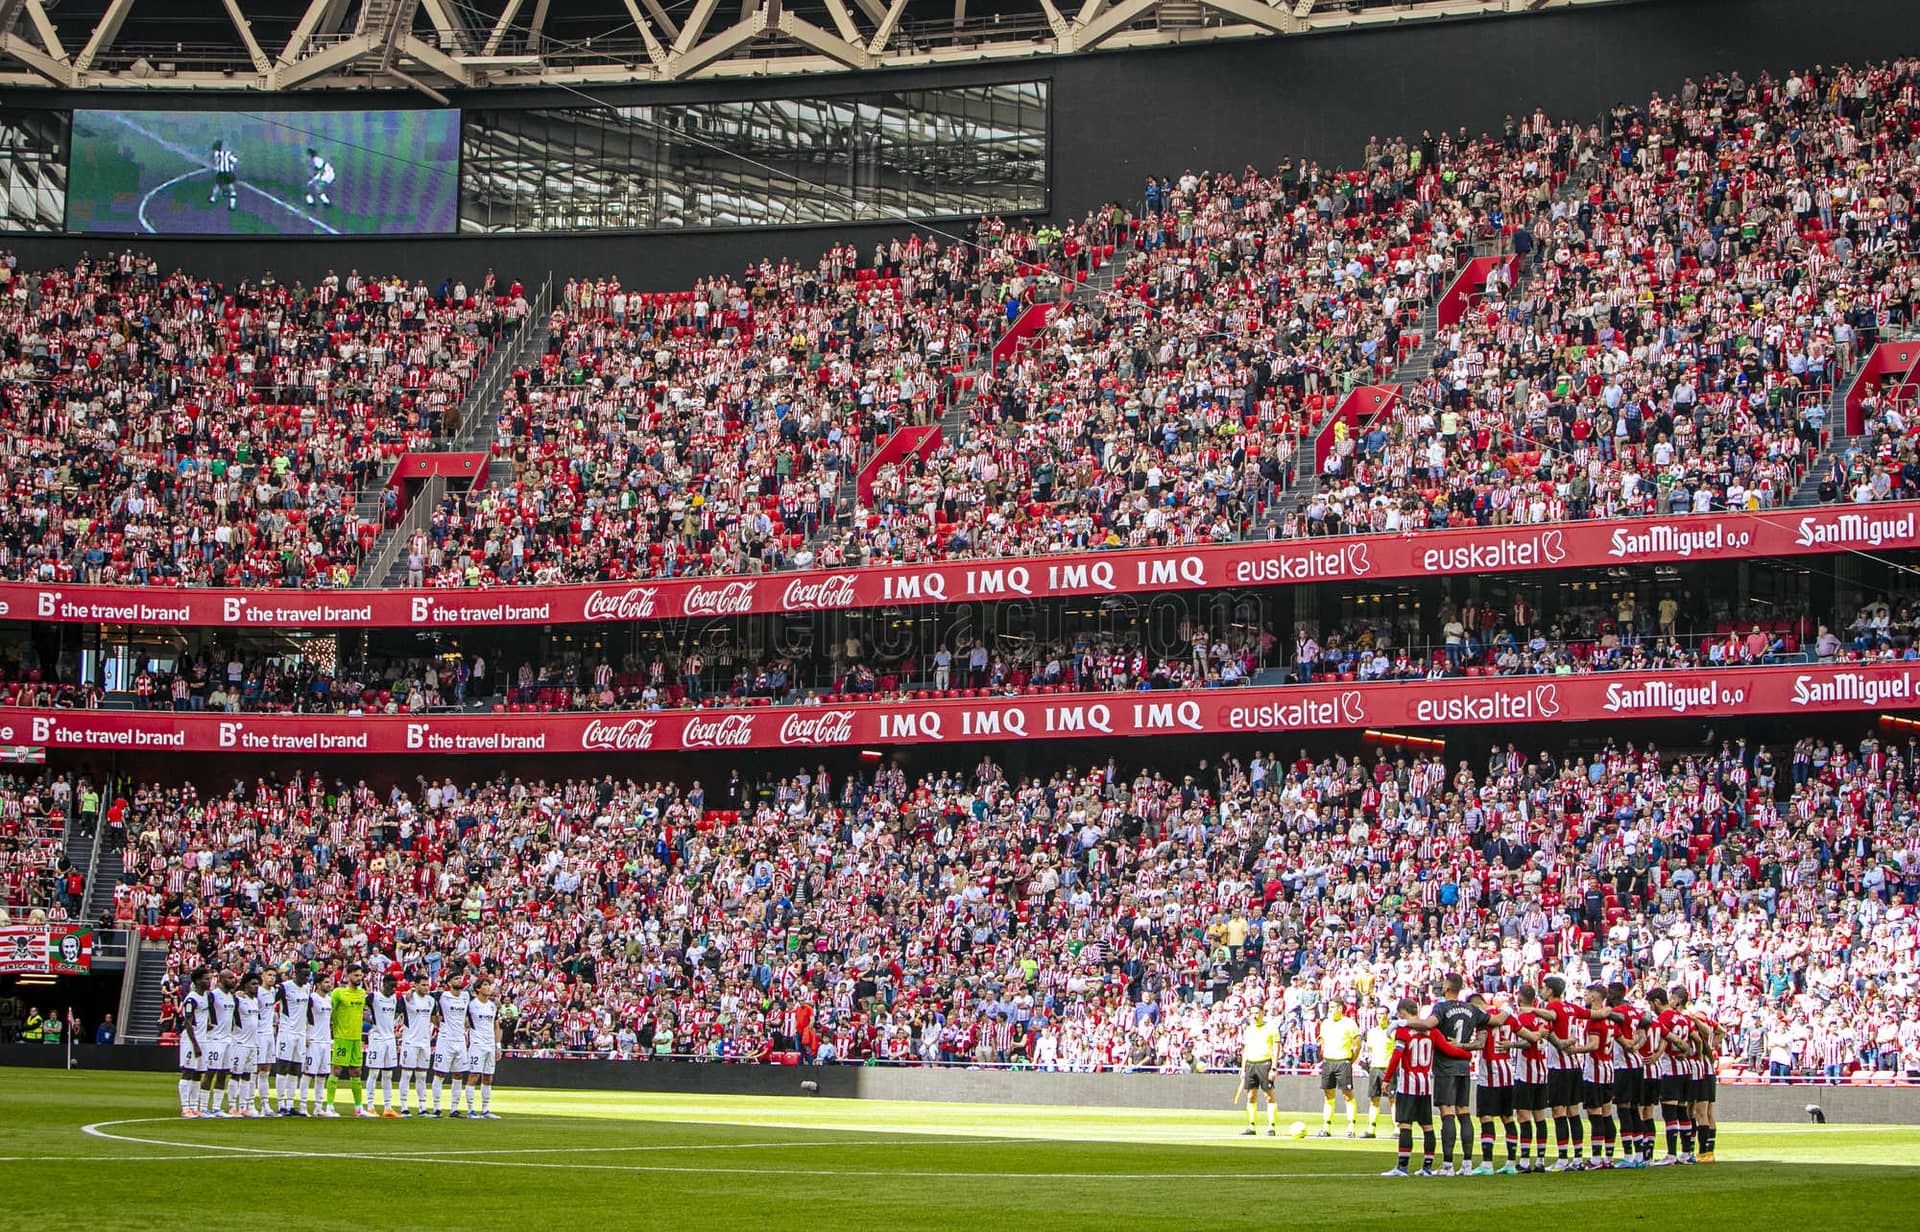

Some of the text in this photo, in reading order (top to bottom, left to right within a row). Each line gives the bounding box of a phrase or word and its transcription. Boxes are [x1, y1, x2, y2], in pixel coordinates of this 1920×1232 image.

[1237, 548, 1345, 582] euskaltel
[1424, 537, 1538, 571] euskaltel
[967, 567, 1033, 595] IMQ
[1049, 561, 1117, 590] IMQ
[1138, 556, 1207, 585] IMQ
[884, 573, 948, 601] IMQ
[61, 602, 88, 618] the
[91, 604, 138, 619] travel
[141, 605, 190, 621] brand
[246, 606, 273, 621] the
[276, 606, 321, 621] travel
[324, 605, 371, 621] brand
[433, 605, 457, 621] the
[460, 604, 502, 621] travel
[506, 603, 549, 620] brand
[1046, 703, 1114, 733] IMQ
[1134, 700, 1204, 730] IMQ
[1230, 697, 1338, 729] euskaltel
[1418, 690, 1531, 721] euskaltel
[55, 727, 83, 742] the
[86, 729, 132, 744] travel
[136, 730, 184, 745] brand
[880, 712, 944, 740] IMQ
[962, 708, 1029, 737] IMQ
[242, 732, 269, 747] the
[272, 733, 317, 748] travel
[320, 732, 367, 748] brand
[428, 733, 453, 748] the
[456, 733, 498, 748] travel
[501, 733, 544, 748] brand
[1453, 1019, 1465, 1044] 1
[208, 1051, 219, 1061] 20
[336, 1048, 347, 1057] 28
[1408, 1037, 1433, 1068] 10
